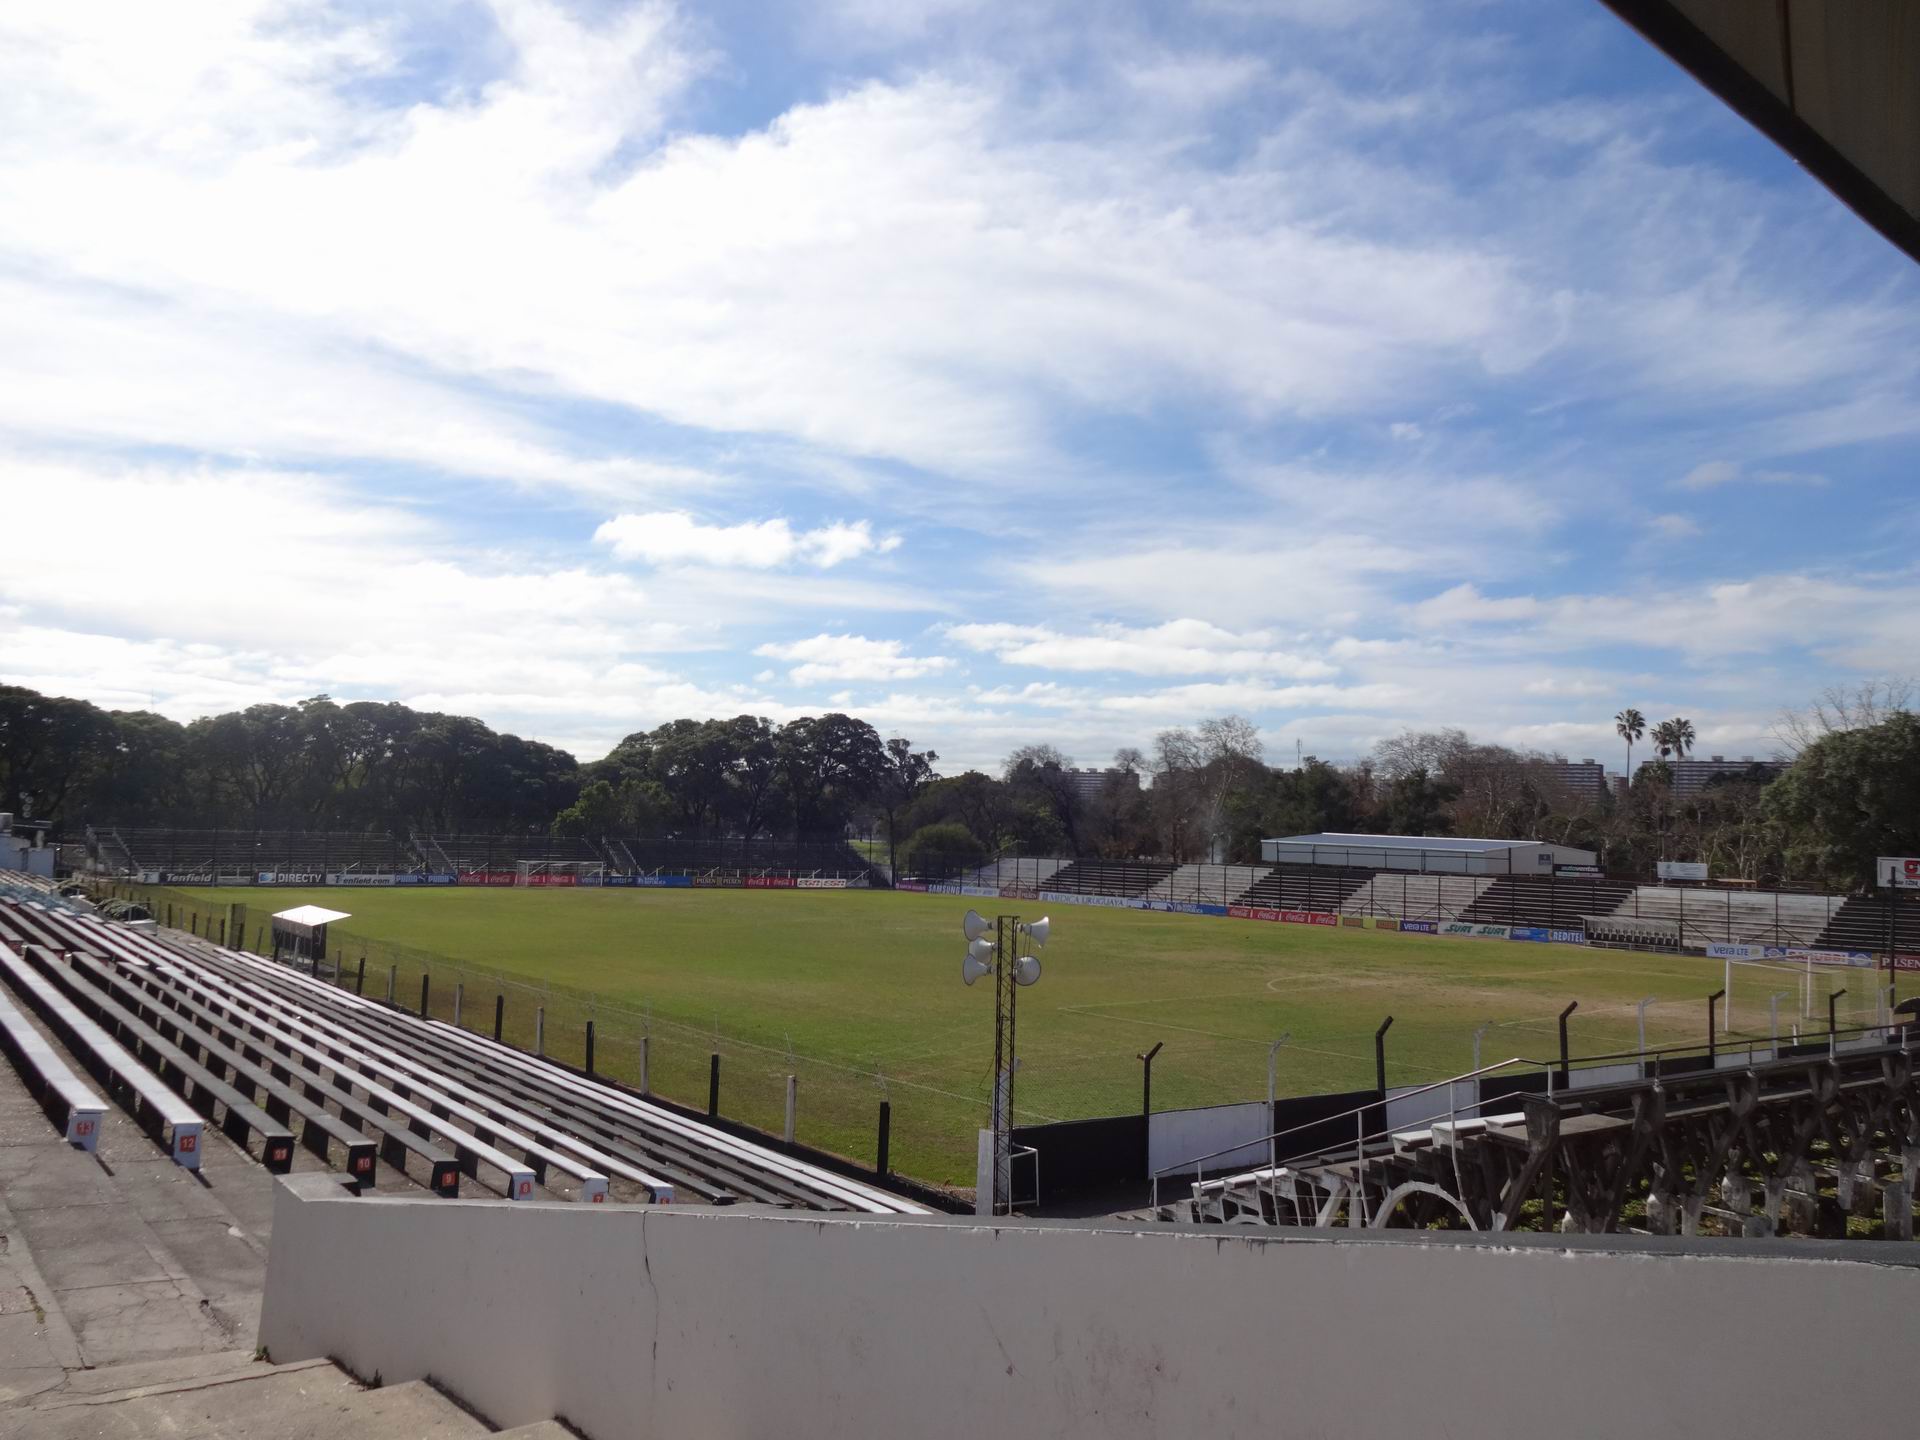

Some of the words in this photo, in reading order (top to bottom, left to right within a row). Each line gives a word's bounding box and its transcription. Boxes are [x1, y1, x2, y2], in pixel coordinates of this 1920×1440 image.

[167, 873, 213, 882] Tenfield
[278, 874, 322, 883] DIRECTV
[928, 885, 960, 895] SAMSUNG
[1445, 924, 1473, 934] SUAT
[1478, 926, 1506, 935] SUAT
[1713, 946, 1735, 955] vera
[1736, 947, 1748, 956] LTE
[1881, 957, 1920, 968] PLSEN
[182, 1138, 195, 1149] 12
[359, 1159, 370, 1169] 10
